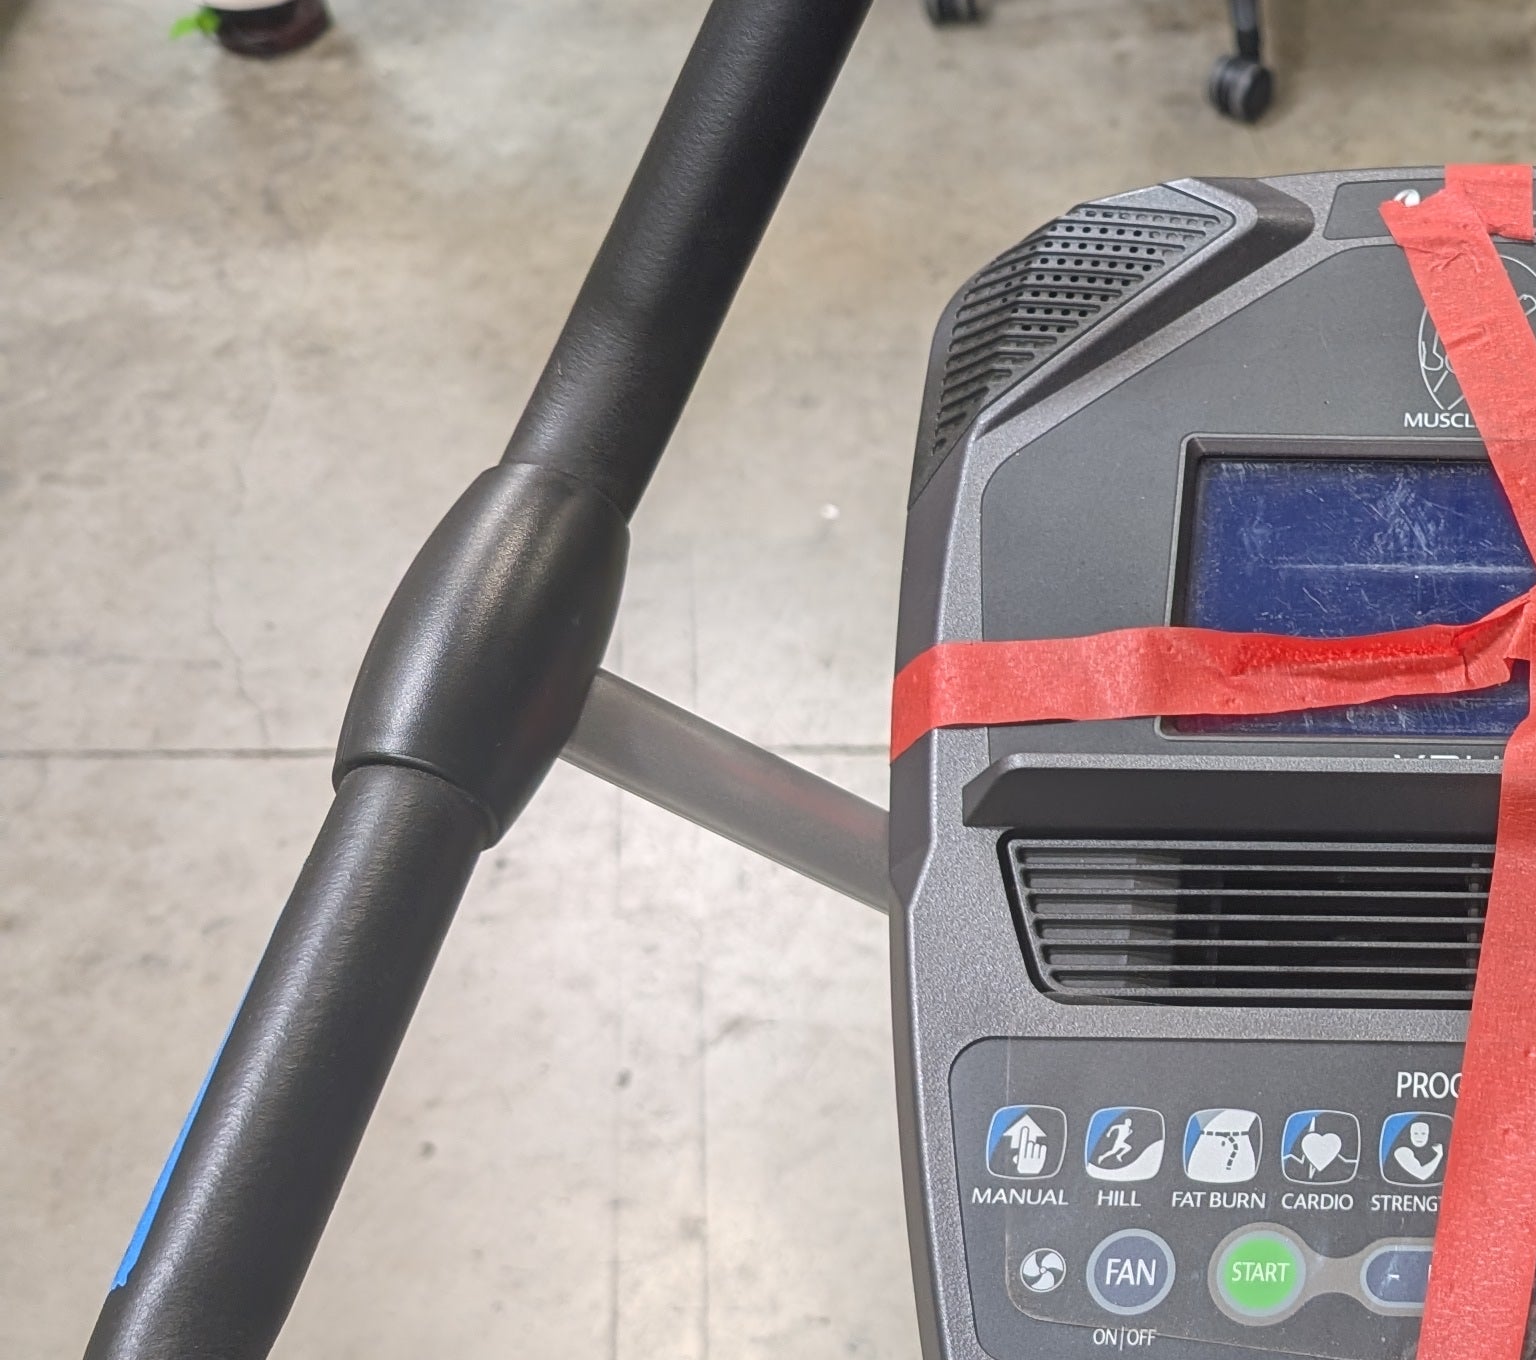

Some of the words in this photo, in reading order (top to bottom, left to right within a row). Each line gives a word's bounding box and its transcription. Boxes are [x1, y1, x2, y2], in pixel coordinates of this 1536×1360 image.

[971, 1187, 1070, 1206] MANUAL
[1097, 1190, 1142, 1207] HILL
[1171, 1191, 1207, 1208] FAT
[1209, 1192, 1267, 1209] BURN
[1281, 1193, 1355, 1211] CARDIO
[1370, 1194, 1442, 1212] STRENG
[1104, 1257, 1157, 1286] FAN
[1231, 1260, 1291, 1283] START
